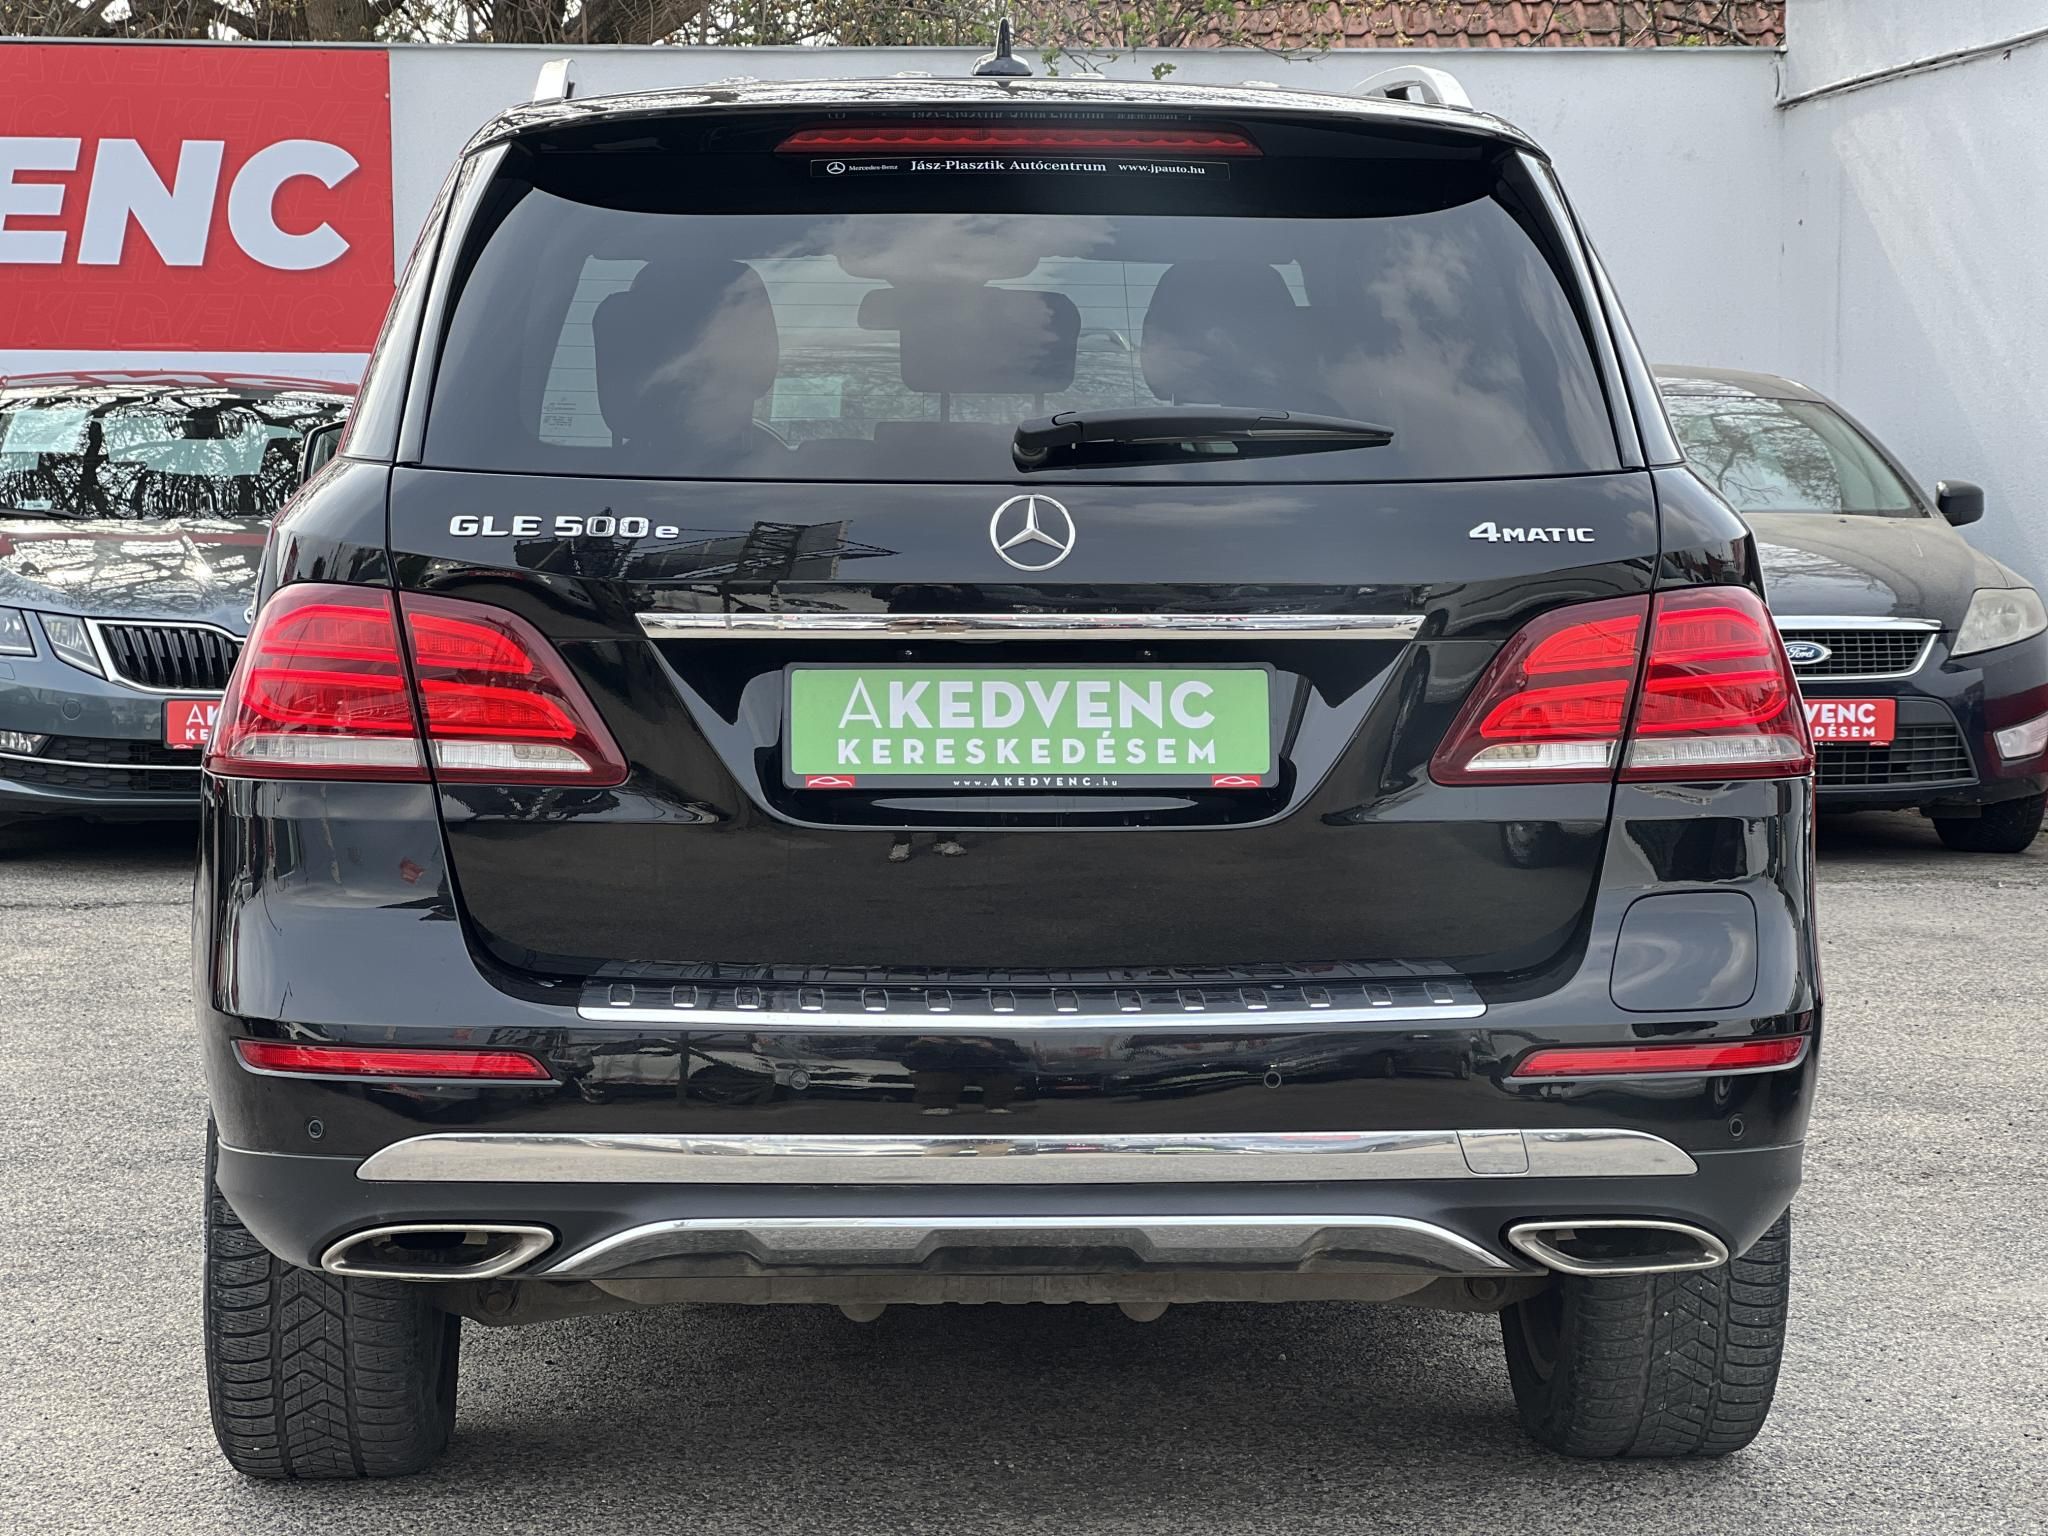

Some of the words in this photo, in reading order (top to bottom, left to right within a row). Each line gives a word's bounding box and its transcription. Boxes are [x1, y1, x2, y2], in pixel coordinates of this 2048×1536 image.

[910, 160, 1005, 171] Jász-Plasztik
[1009, 160, 1106, 171] Autócentrum
[1118, 163, 1205, 174] www.jpauto.hu
[0, 137, 360, 270] ENC
[449, 515, 542, 537] GLE
[1469, 522, 1595, 542] 4MATIC
[1788, 647, 1815, 658] Ford
[838, 677, 1216, 729] AKEDVENC
[838, 731, 1216, 765] KERESKEDÉSEM
[953, 777, 1118, 786] www.AKEDVENC.hu
